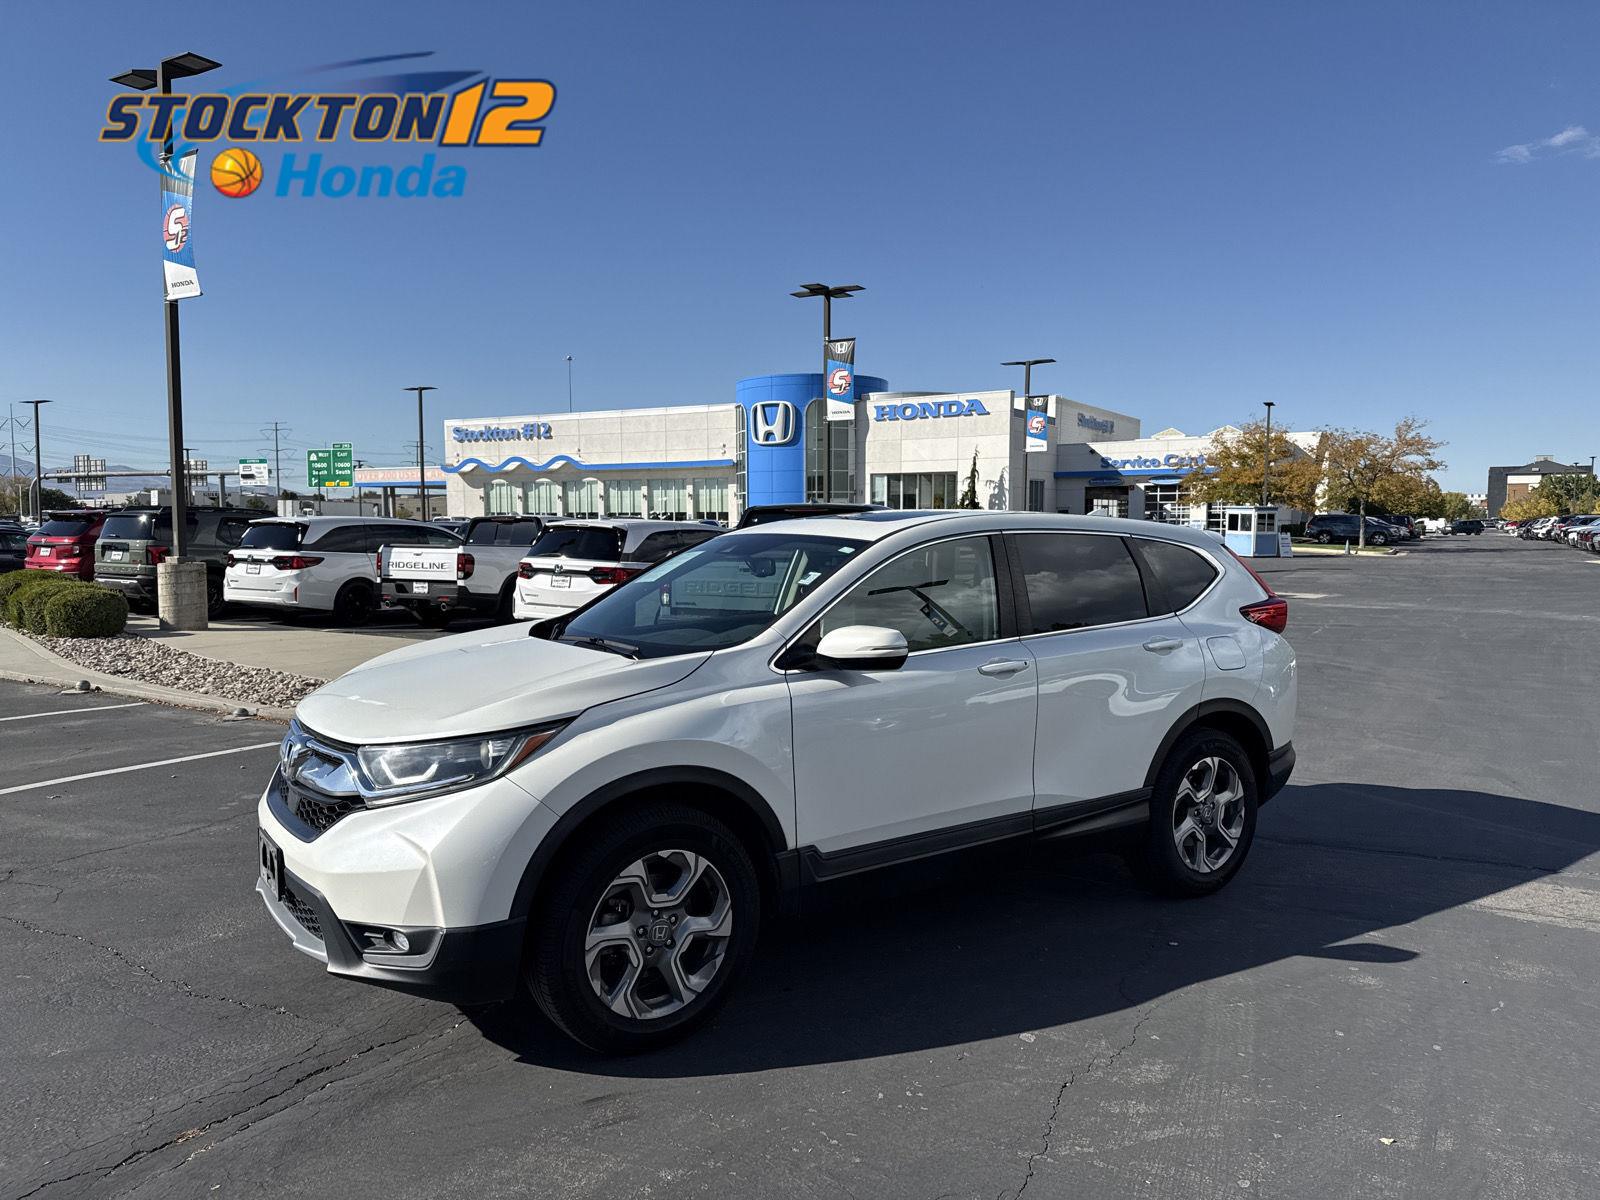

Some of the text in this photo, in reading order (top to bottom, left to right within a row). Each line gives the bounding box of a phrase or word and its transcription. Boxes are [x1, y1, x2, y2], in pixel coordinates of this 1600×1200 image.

[171, 279, 195, 289] HONDA
[873, 398, 991, 422] HONDA
[452, 422, 553, 443] Stockton #12
[1101, 453, 1206, 469] Service Cent
[387, 561, 448, 570] RIDGELINE
[684, 580, 779, 595] RIDGELI
